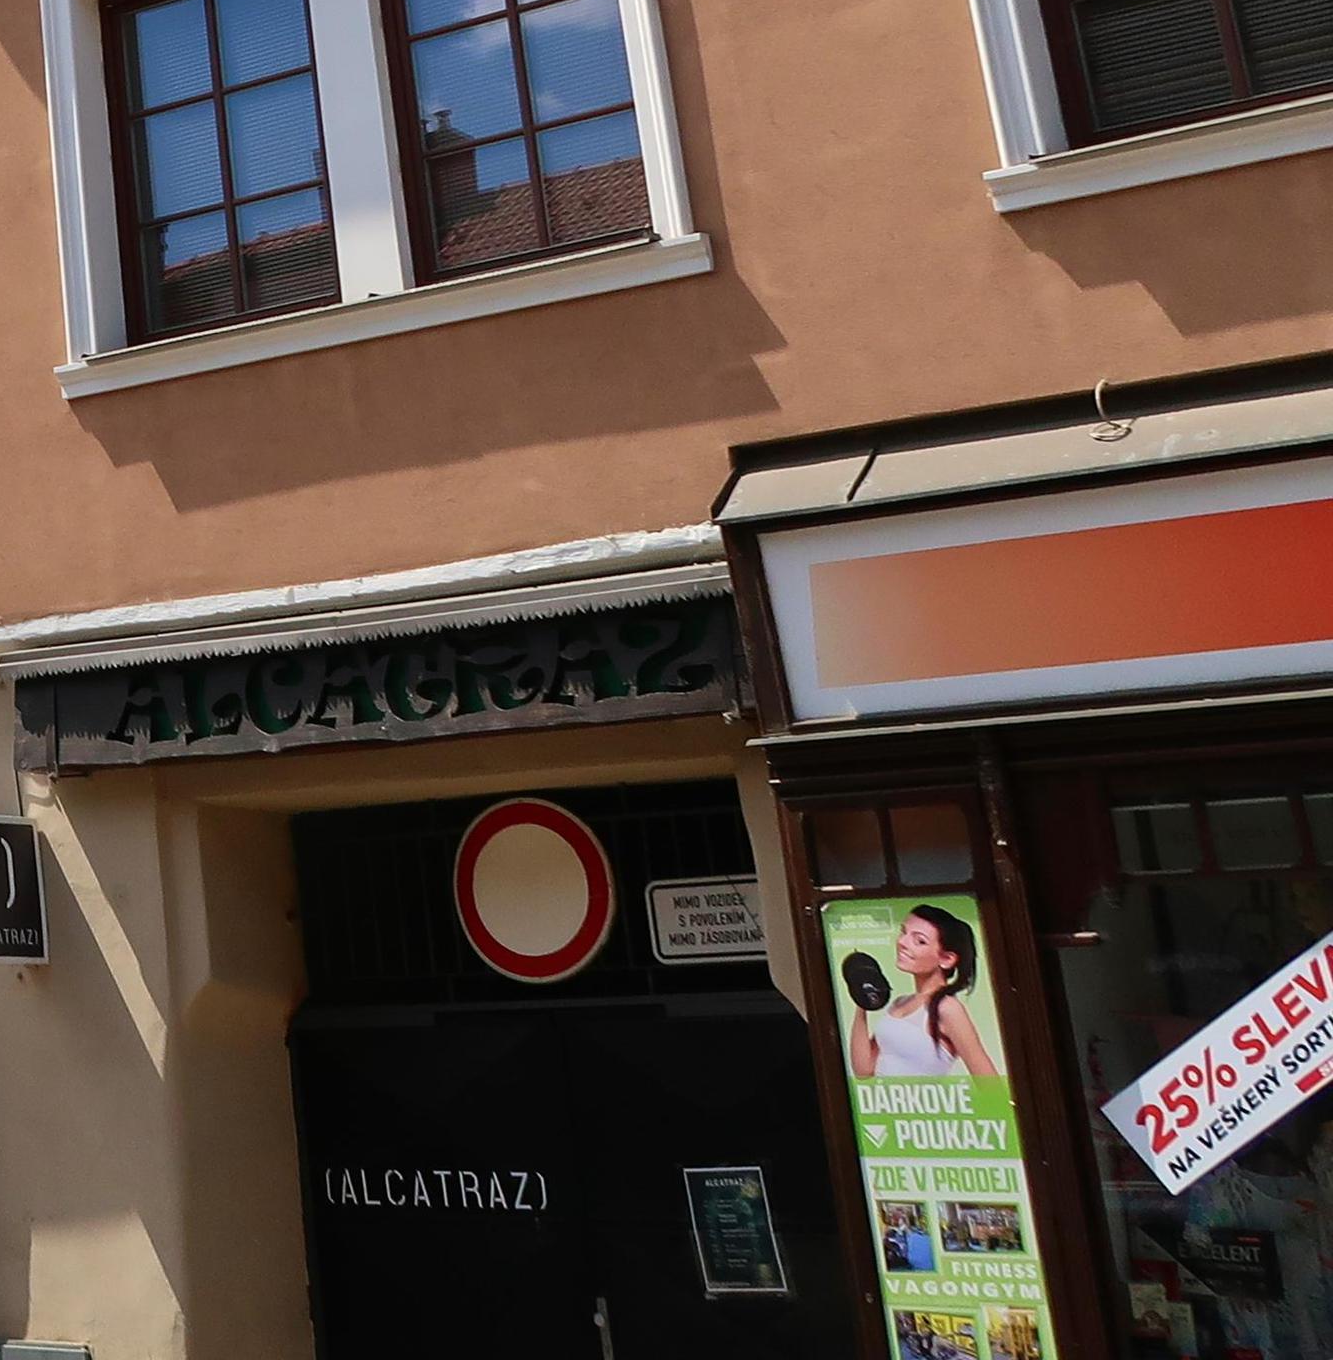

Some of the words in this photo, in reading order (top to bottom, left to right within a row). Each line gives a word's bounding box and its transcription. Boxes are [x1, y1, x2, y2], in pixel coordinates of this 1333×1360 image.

[673, 896, 700, 909] MIMO
[678, 914, 686, 928] S
[689, 911, 746, 927] POVOLENÍM
[669, 932, 696, 946] MIMO
[1136, 1045, 1239, 1155] 25%
[1232, 944, 1333, 1065] SLEV
[856, 1080, 974, 1114] DÁRKOVÉ
[1167, 1146, 1202, 1180] NA
[1196, 1065, 1283, 1151] VEŠKERÝ
[1281, 1014, 1333, 1076] SORT
[894, 1119, 1007, 1151] POUKAZY
[325, 1168, 548, 1210] (ALCATRAZ)
[869, 1165, 908, 1191] ZDE
[912, 1166, 927, 1192] V
[934, 1166, 1019, 1193] PRODEJI
[950, 1261, 1038, 1280] FITNESS
[885, 1278, 1042, 1300] VAGONGYM
